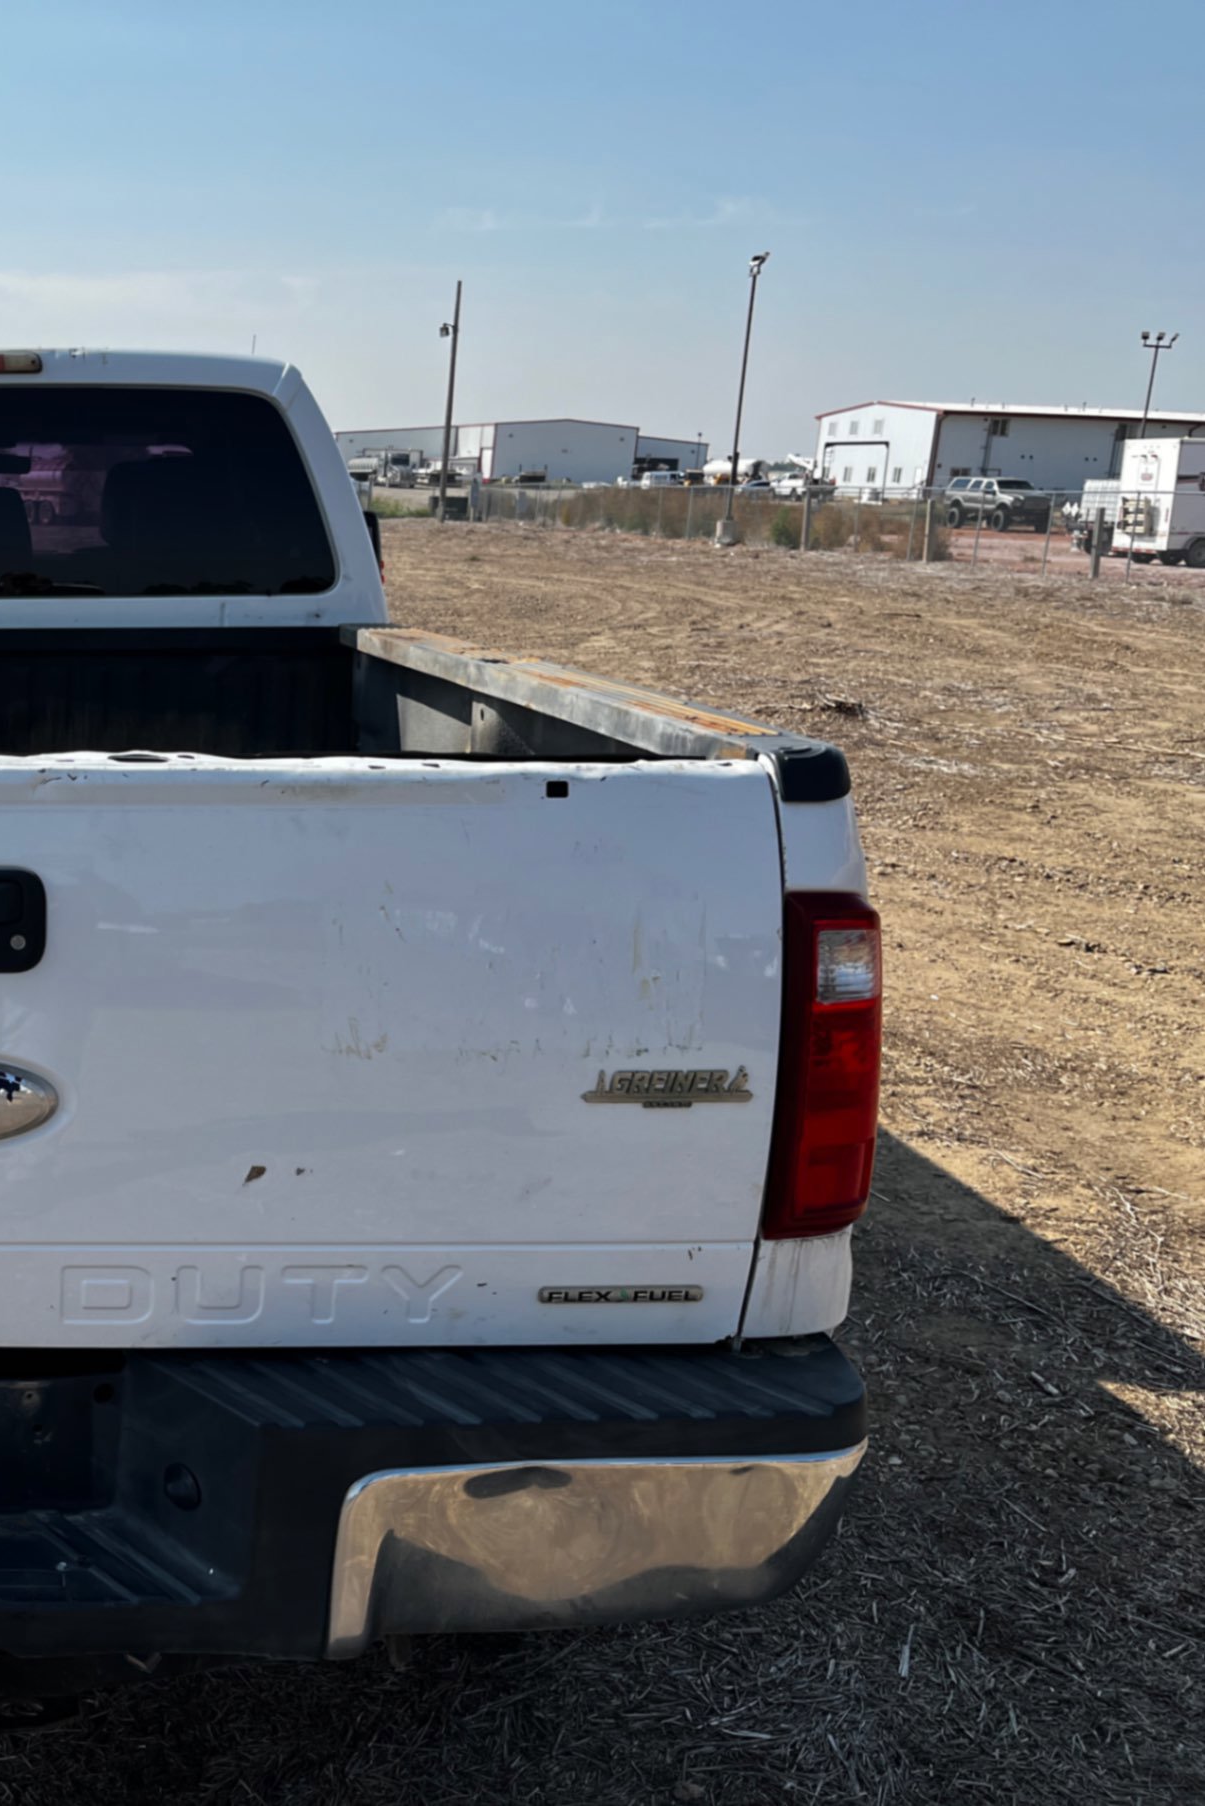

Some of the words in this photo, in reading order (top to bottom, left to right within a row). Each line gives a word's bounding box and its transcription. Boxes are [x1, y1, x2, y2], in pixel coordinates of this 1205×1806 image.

[610, 1069, 730, 1094] GREINER
[60, 1264, 464, 1325] DUTY
[547, 1290, 613, 1302] FLEX
[632, 1290, 698, 1302] FUEL
